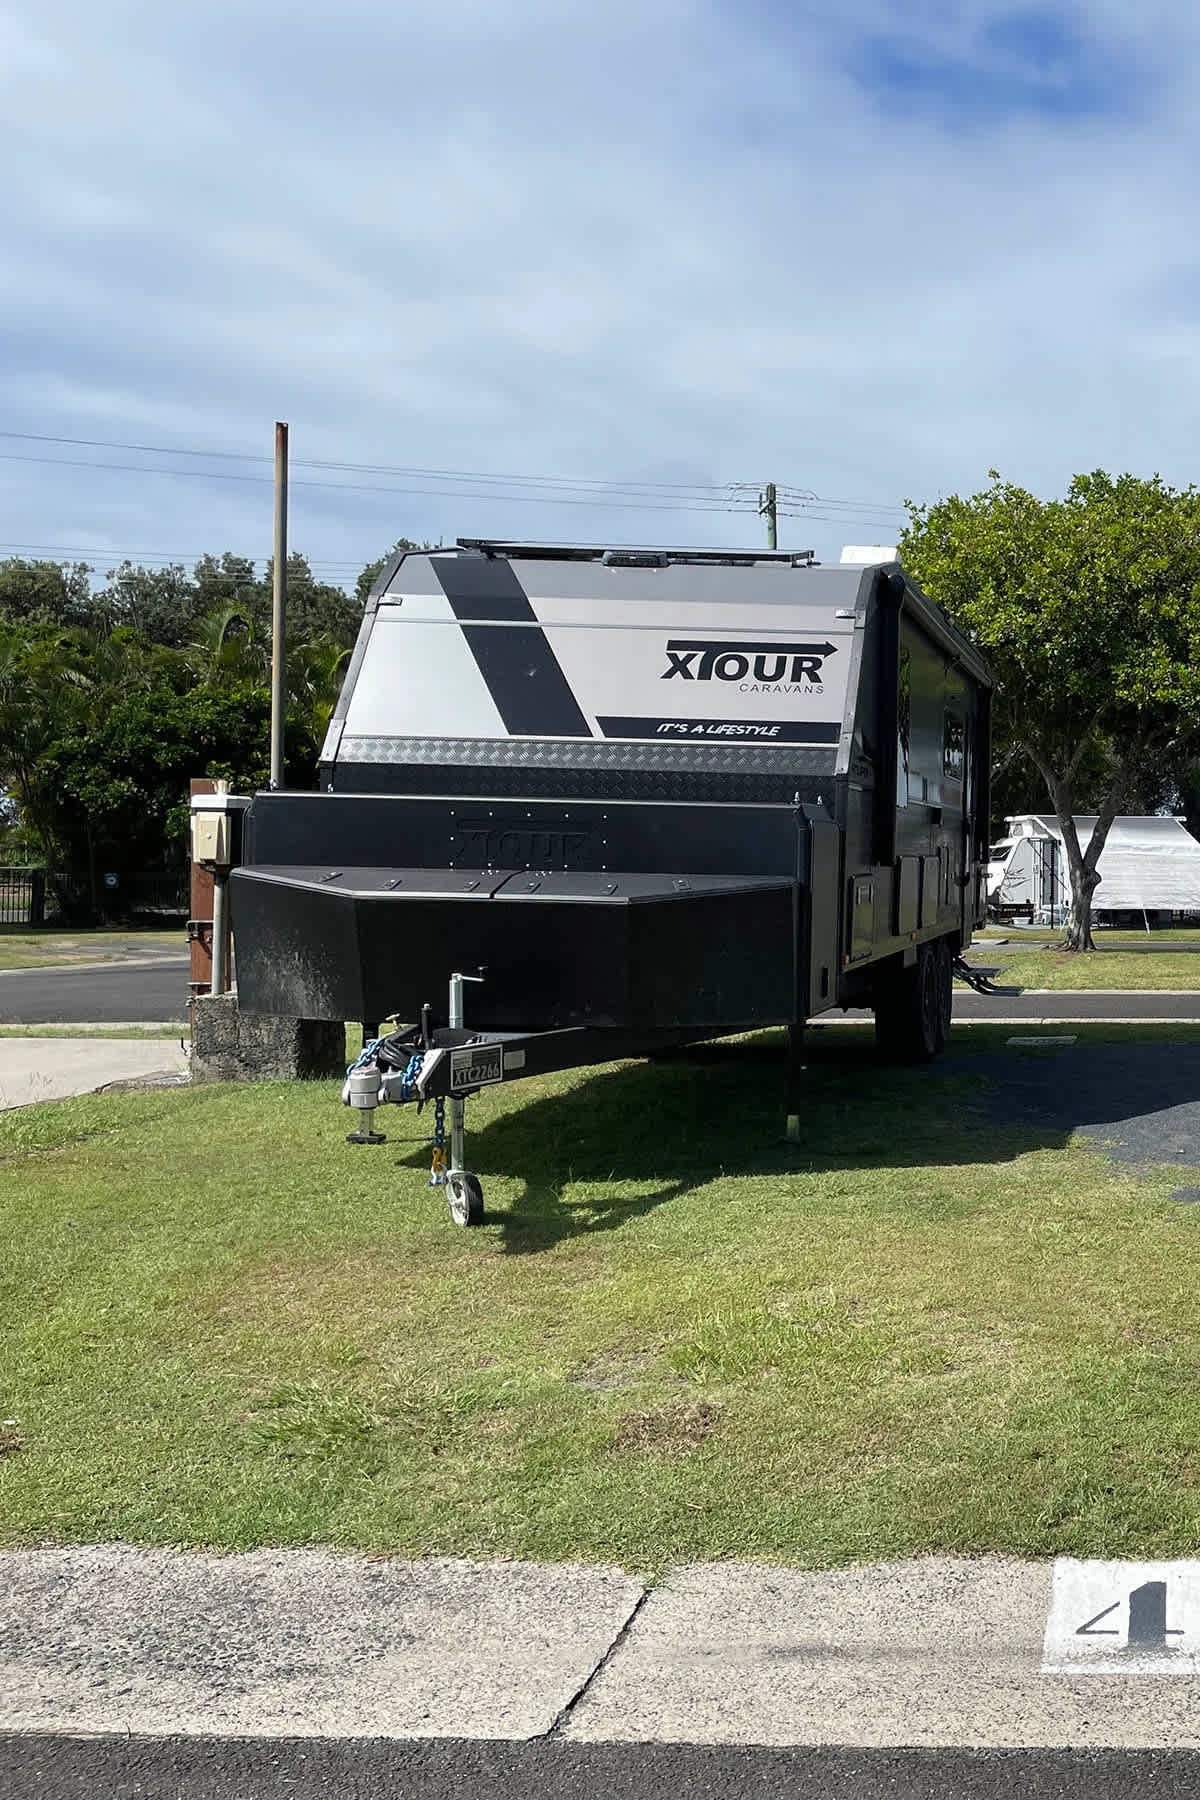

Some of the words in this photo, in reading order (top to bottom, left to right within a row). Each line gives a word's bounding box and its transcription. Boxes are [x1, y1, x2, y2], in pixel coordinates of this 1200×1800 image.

[660, 640, 838, 683] XTOUR
[739, 683, 825, 695] CARAVANS
[656, 722, 688, 734] IT'S
[691, 725, 705, 734] A
[706, 724, 782, 736] LIFESTYLE
